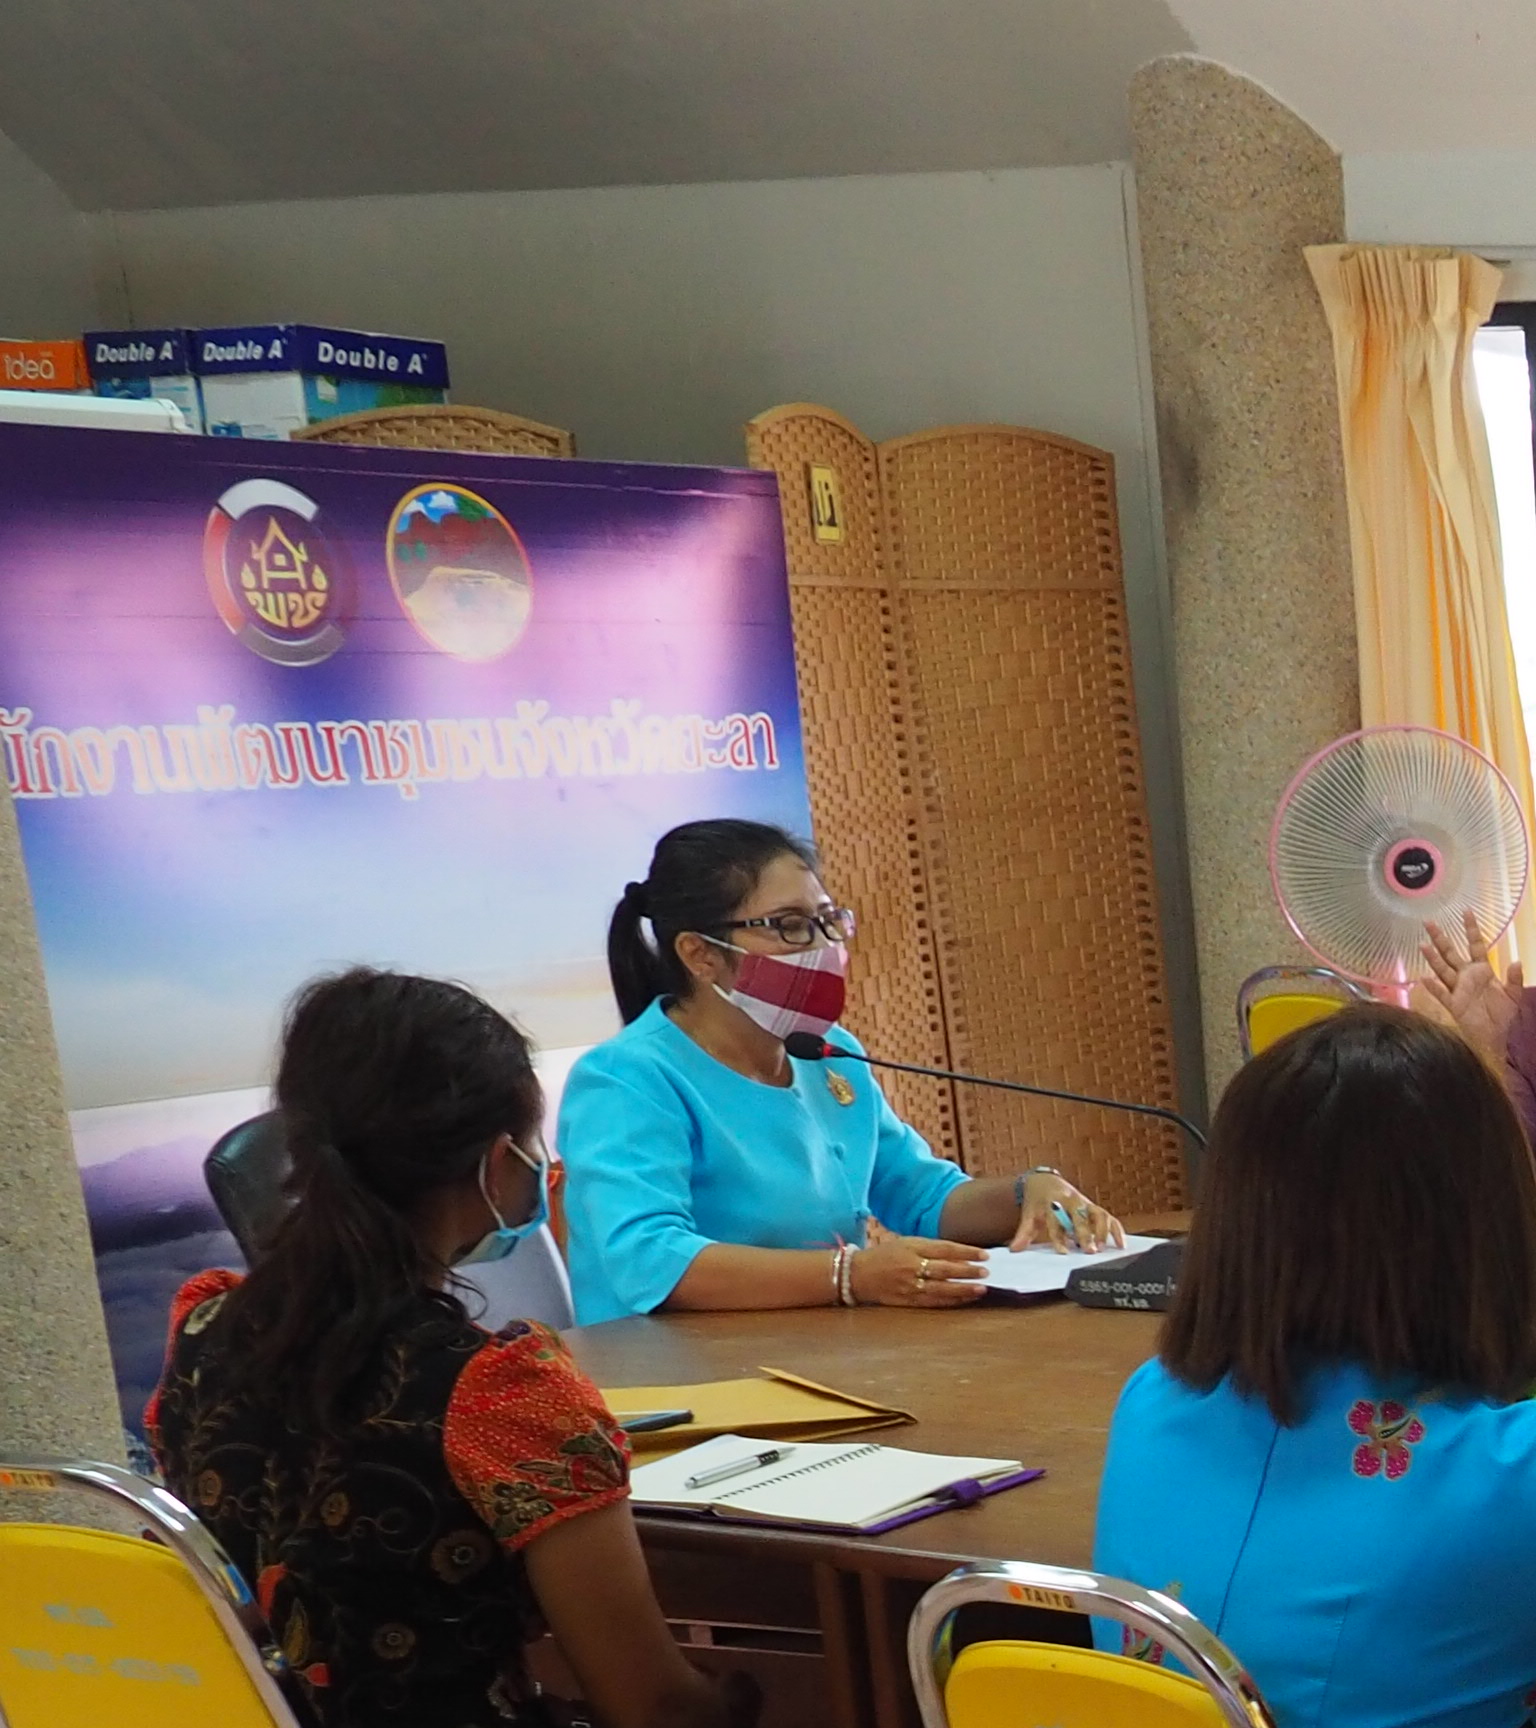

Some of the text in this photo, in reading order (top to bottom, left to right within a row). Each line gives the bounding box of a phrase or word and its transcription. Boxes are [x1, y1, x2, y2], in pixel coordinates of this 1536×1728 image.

[95, 341, 174, 363] Double A
[202, 339, 283, 362] Double A
[317, 341, 424, 375] Double A
[1022, 1587, 1075, 1609] TAIYO
